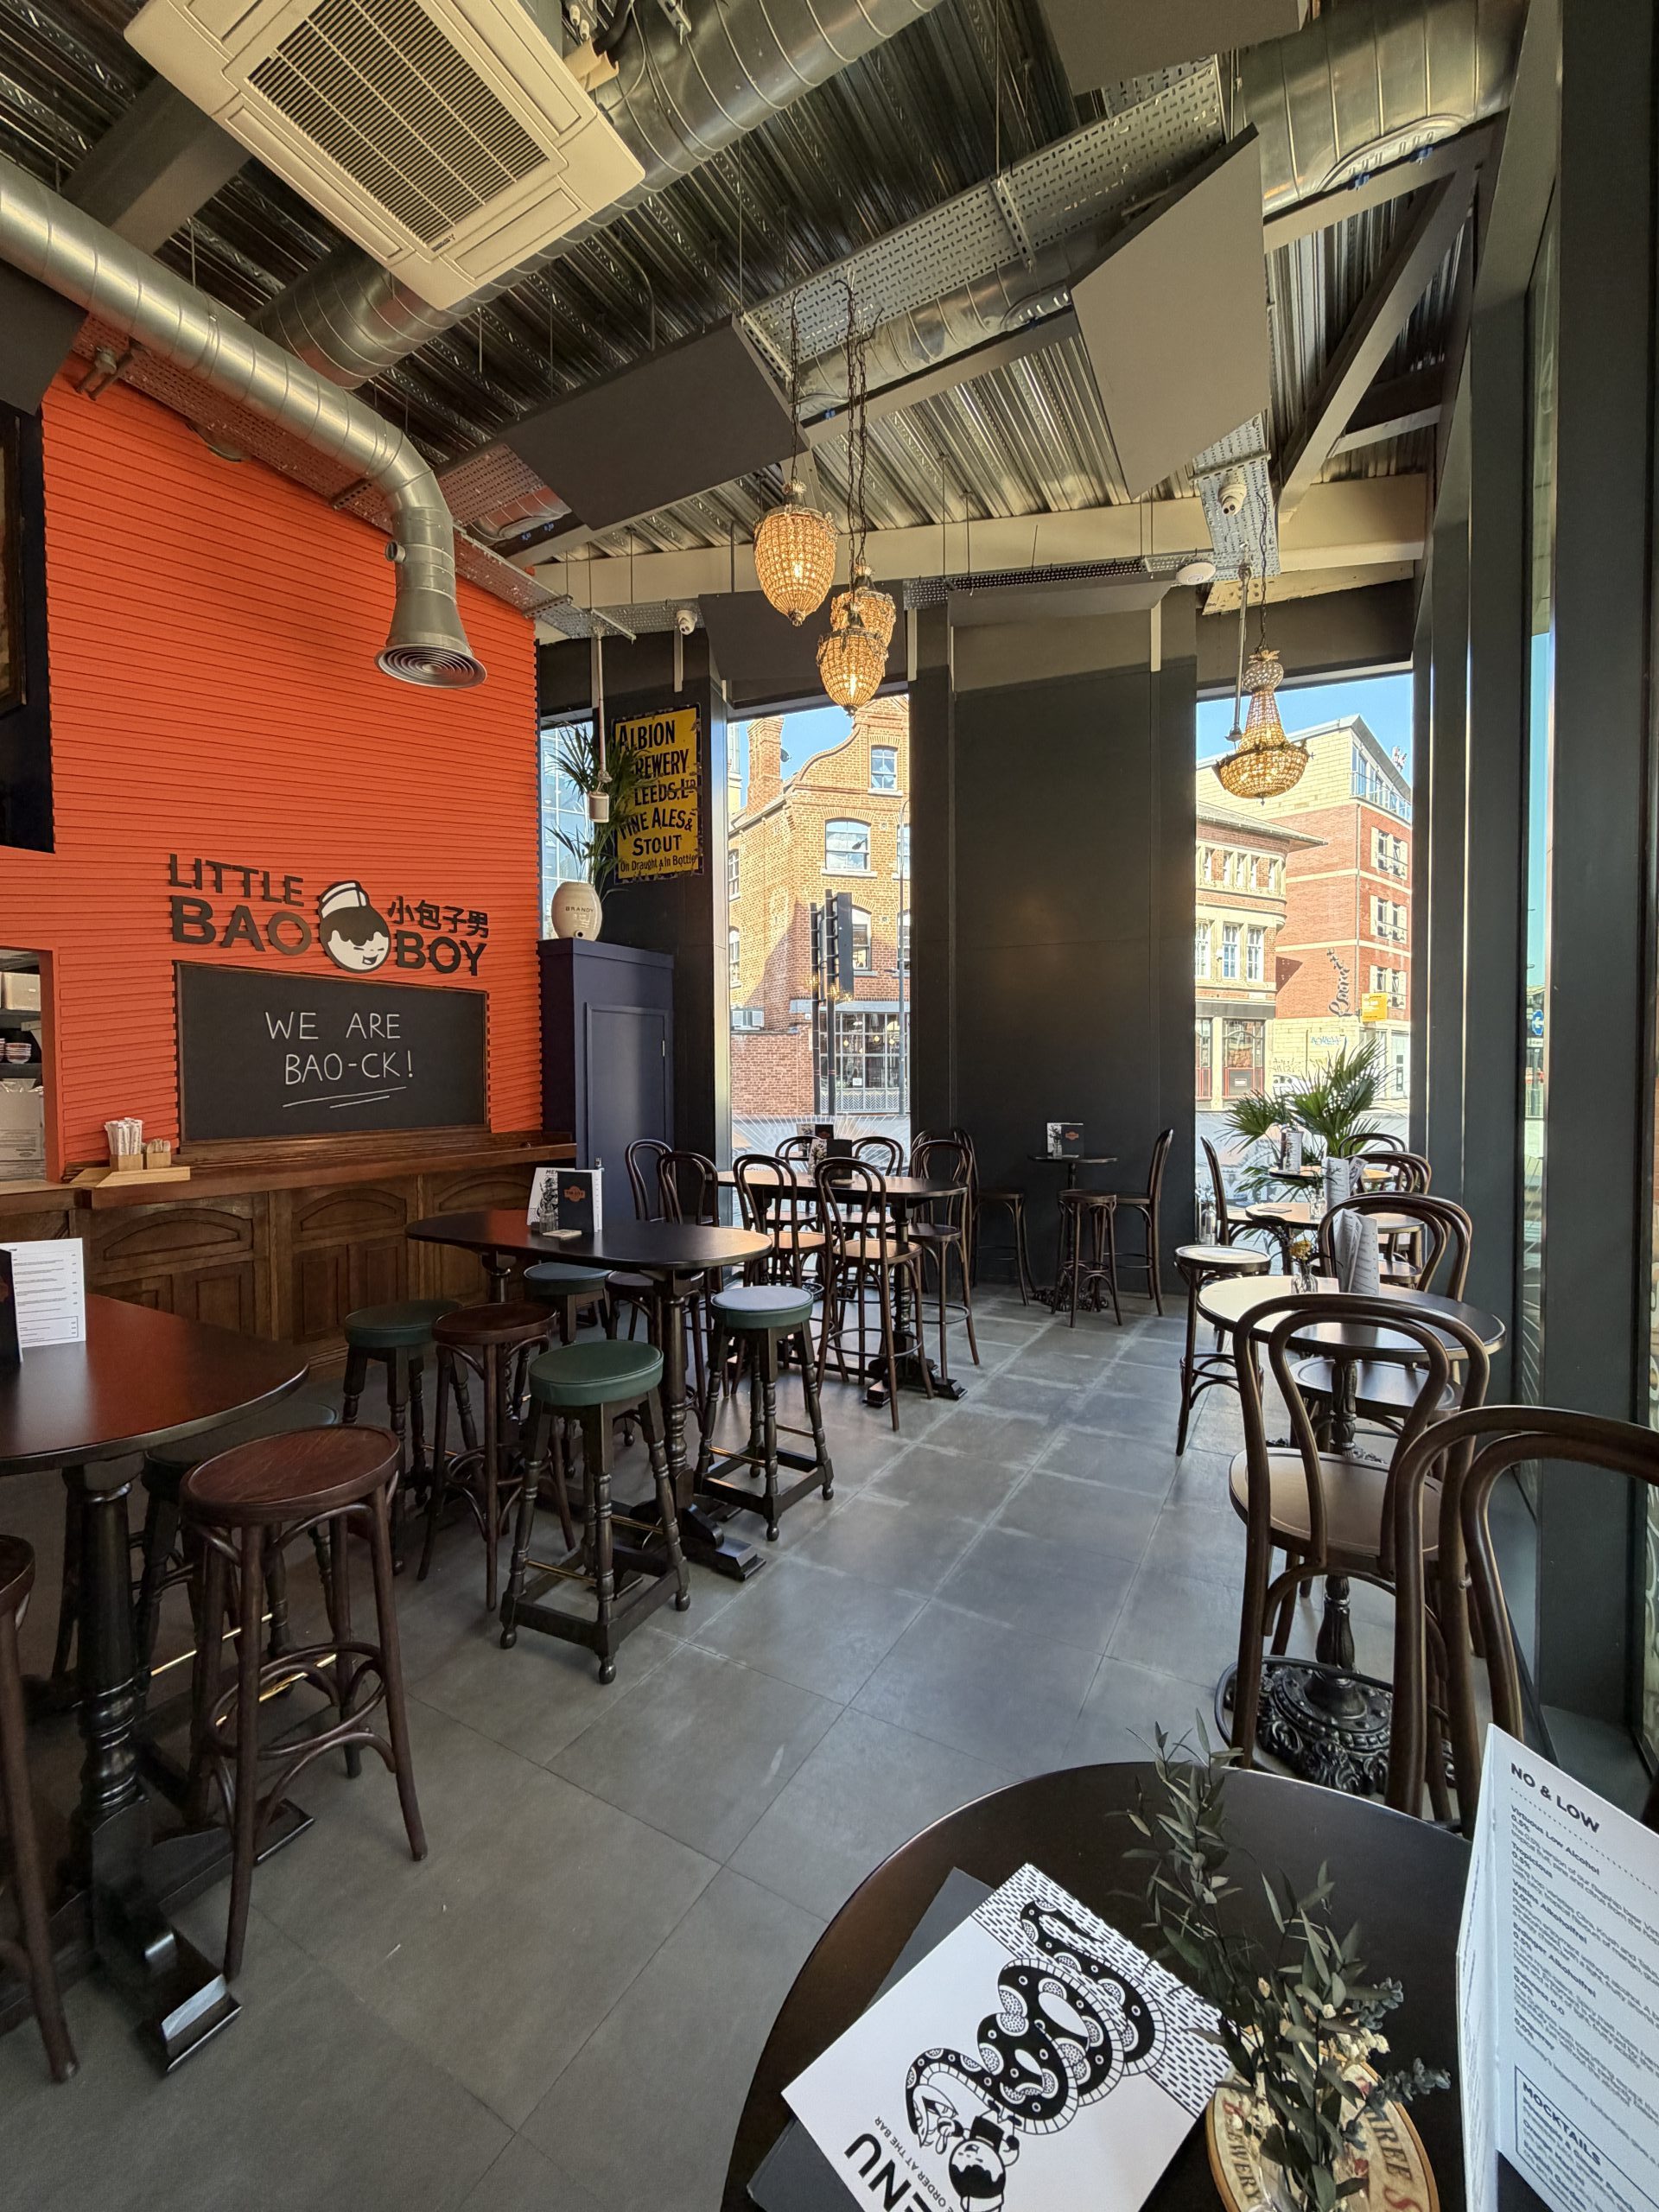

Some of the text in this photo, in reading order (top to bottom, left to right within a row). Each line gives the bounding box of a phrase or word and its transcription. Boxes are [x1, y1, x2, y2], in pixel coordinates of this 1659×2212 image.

[619, 720, 675, 753] ALBION
[634, 749, 690, 779] REWERY
[652, 807, 686, 829] ALES
[684, 817, 693, 831] &
[632, 835, 681, 855] STOUT
[169, 854, 304, 906] LITTLE
[620, 861, 629, 872] On
[632, 857, 657, 871] Draught
[664, 857, 671, 866] In
[388, 895, 489, 938] 小包子男
[171, 894, 487, 976] BAO BOY
[265, 1011, 401, 1039] WE ARE
[1511, 1762, 1599, 1834] NO & LOW
[1511, 1812, 1529, 1833] 0.5%
[1511, 1804, 1599, 1876] Virtuous Low Alcohol
[1511, 1840, 1552, 1878] Tropicious
[1511, 1849, 1530, 1870] 0.5%
[1511, 1821, 1523, 1837] The
[1541, 1846, 1566, 1869] version
[1567, 1865, 1575, 1877] of
[1591, 1882, 1621, 1911] flagship
[1512, 1886, 1532, 1909] 0.0%
[1569, 1873, 1583, 1889] and
[1512, 1878, 1586, 1945] Veltins Alkoholfrei
[1513, 1929, 1531, 1952] 0.5%
[1513, 1921, 1595, 1999] Erdinger Alkoholfrei
[1513, 1973, 1533, 1997] 0.0%
[1513, 1963, 1564, 2017] Guinness 0.0
[1514, 2015, 1534, 2040] 0.0%
[1514, 2007, 1554, 2052] Tanqueray
[1522, 2081, 1600, 2168] MOCKTAILS
[874, 2116, 946, 2208] ORDER AT THE BAR
